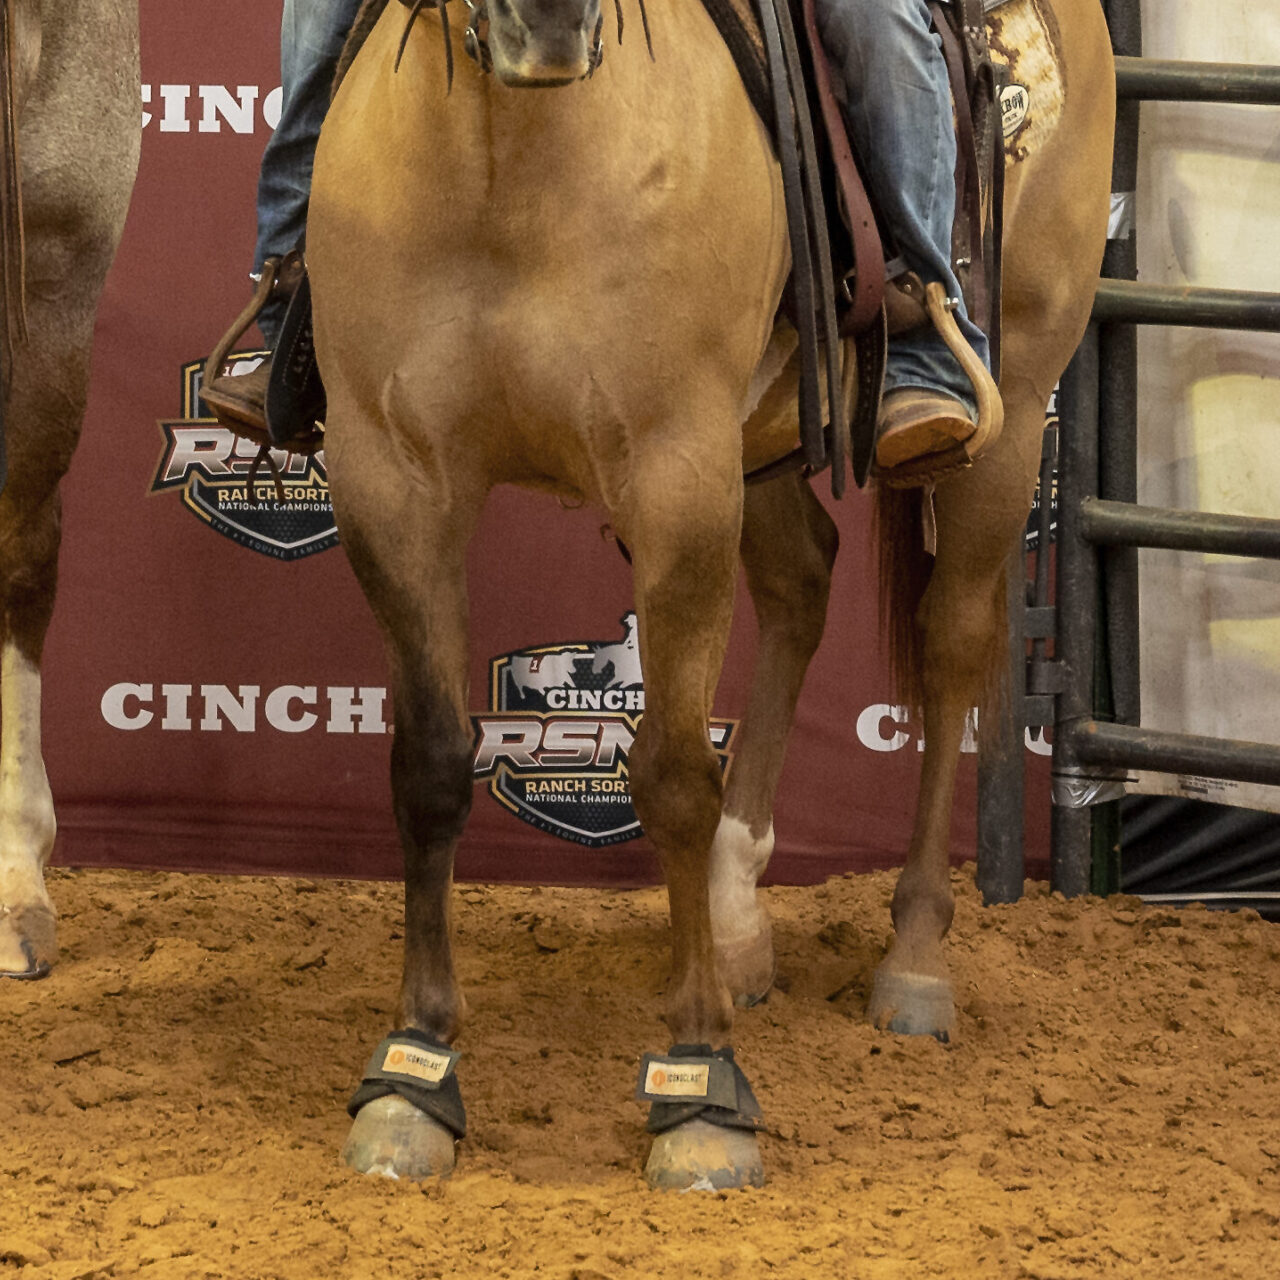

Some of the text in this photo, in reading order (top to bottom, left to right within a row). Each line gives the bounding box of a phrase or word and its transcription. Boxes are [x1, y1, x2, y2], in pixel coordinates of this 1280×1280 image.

[283, 487, 332, 502] SORT
[546, 689, 646, 711] CINCH
[100, 683, 388, 734] CINCH
[525, 780, 586, 793] RANCH
[525, 794, 578, 803] NATIONAL
